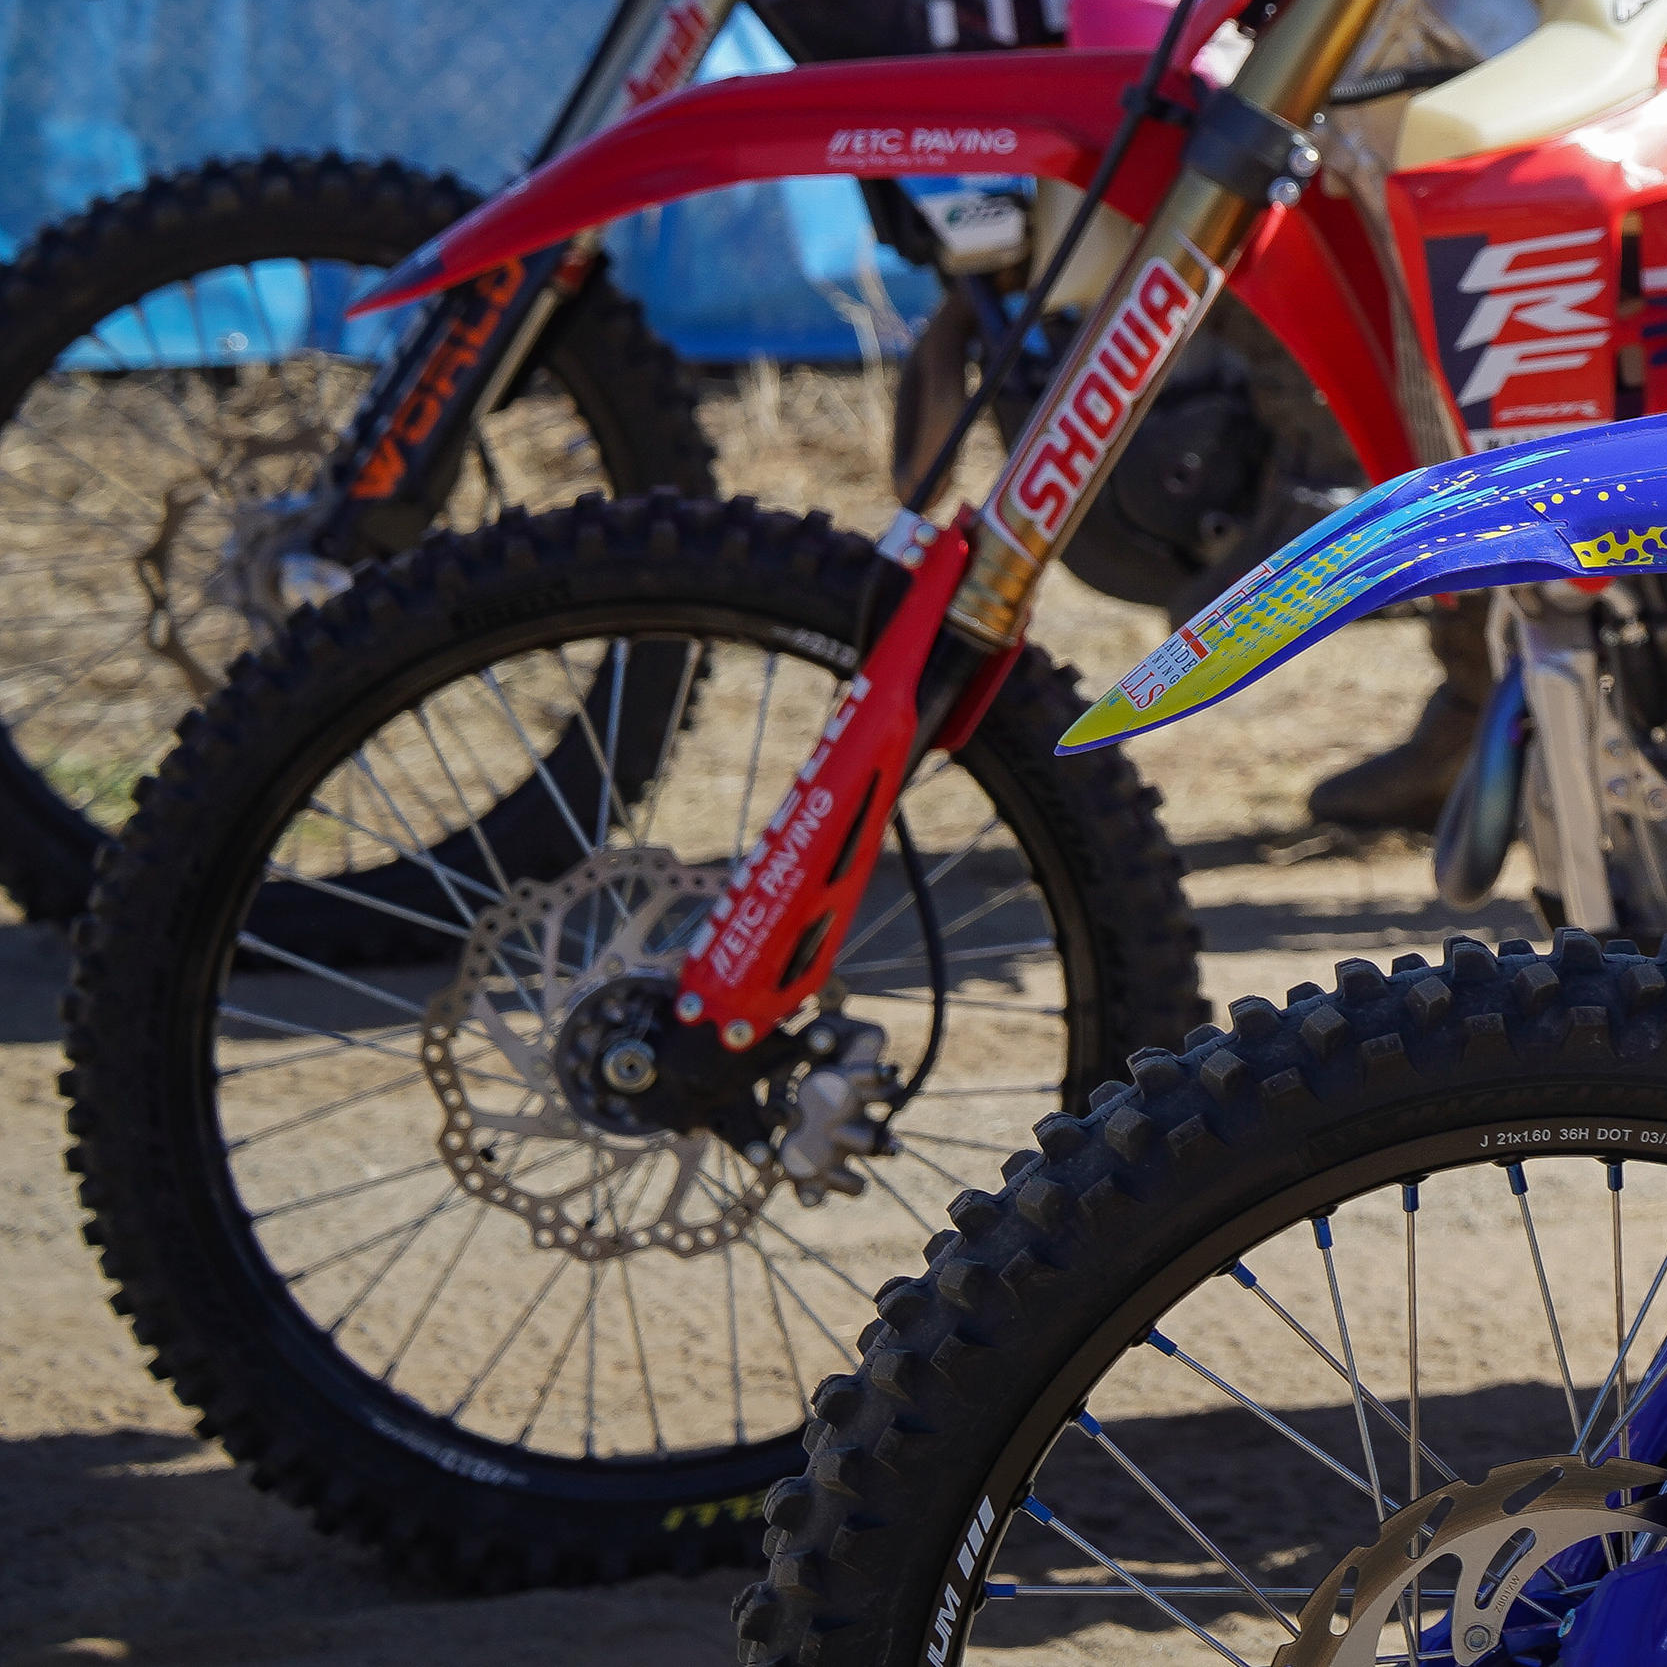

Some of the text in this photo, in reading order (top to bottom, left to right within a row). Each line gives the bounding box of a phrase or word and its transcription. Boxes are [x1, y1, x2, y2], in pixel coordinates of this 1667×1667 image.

[1456, 227, 1610, 409] CRF
[1012, 256, 1194, 536] SHOWA
[1151, 652, 1182, 685] NING
[1163, 636, 1199, 674] AIDE
[1121, 663, 1165, 710] LLS
[1480, 1132, 1491, 1148] J
[1495, 1128, 1552, 1145] 21x1.60
[1559, 1126, 1590, 1142] 36H
[1596, 1127, 1633, 1143] DOT
